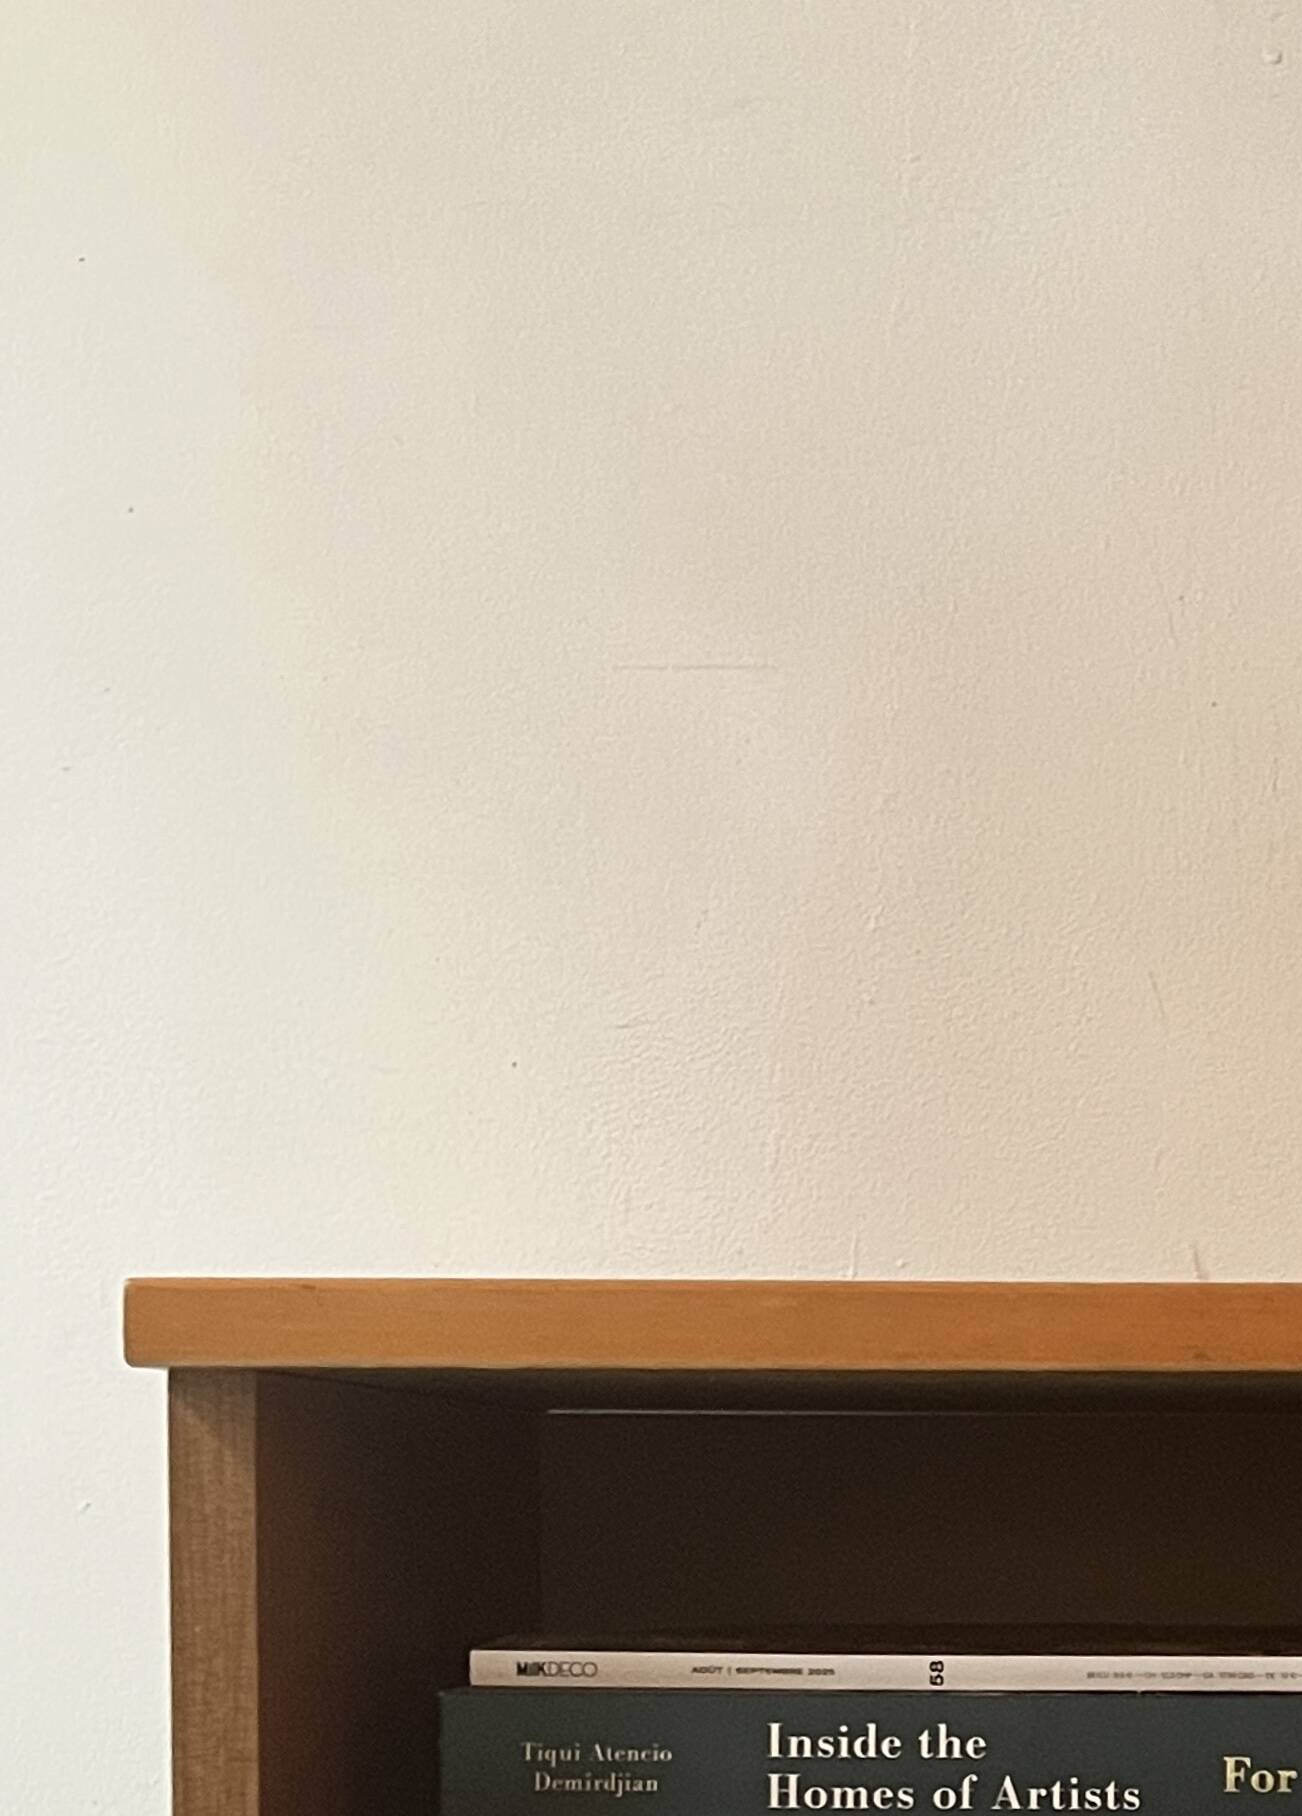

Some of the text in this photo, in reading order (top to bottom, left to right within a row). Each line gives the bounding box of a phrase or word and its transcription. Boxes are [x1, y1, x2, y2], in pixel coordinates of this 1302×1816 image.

[521, 1742, 673, 1768] Tiqui Atencio
[767, 1722, 987, 1760] Inside the
[534, 1771, 658, 1798] Demirdjian
[767, 1773, 1141, 1811] Homes of Artists
[1223, 1756, 1298, 1793] For
